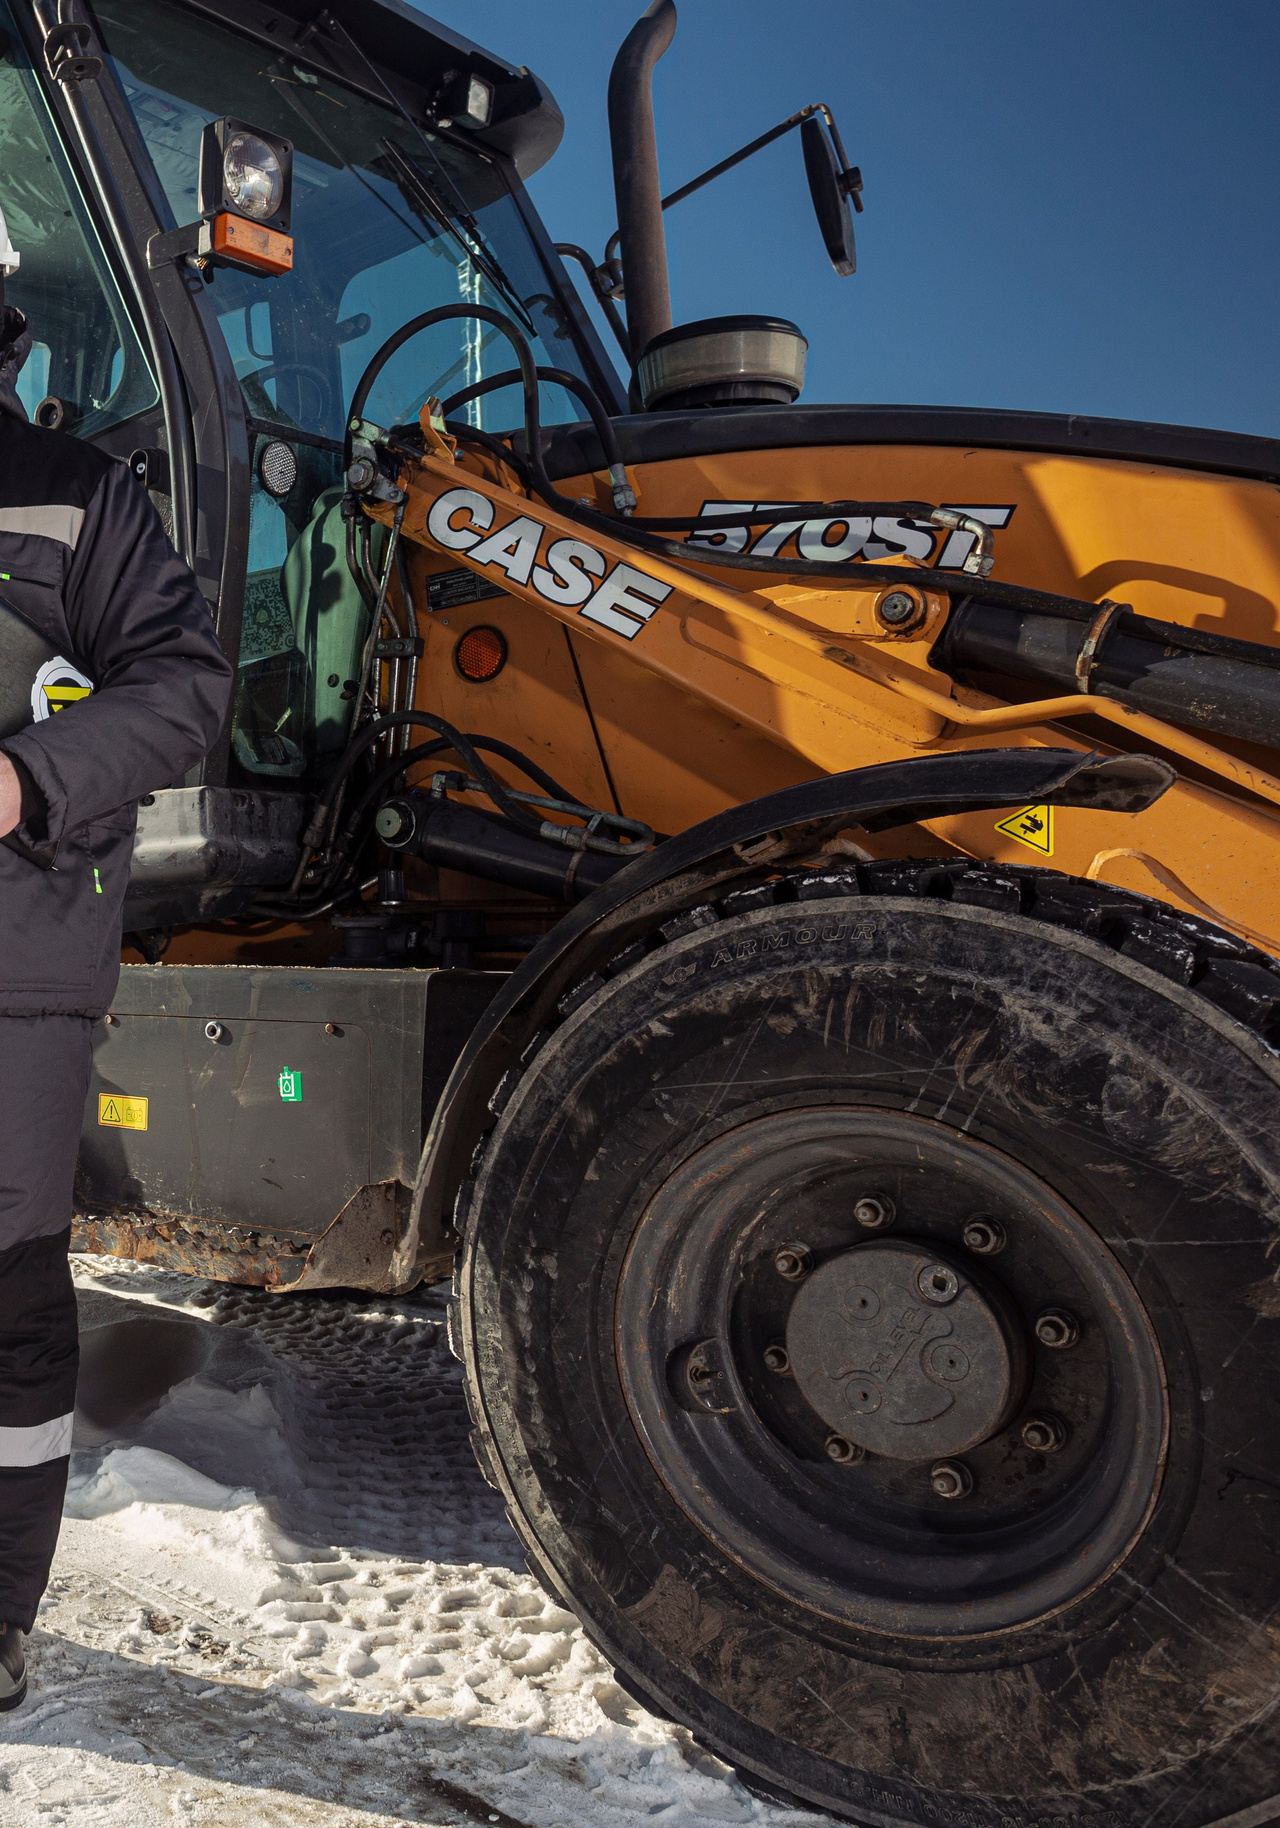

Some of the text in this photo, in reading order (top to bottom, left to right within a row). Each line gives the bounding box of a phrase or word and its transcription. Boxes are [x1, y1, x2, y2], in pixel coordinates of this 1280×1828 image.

[426, 487, 675, 641] CASE
[683, 500, 1018, 571] 570ST
[710, 924, 877, 968] ARMOUR
